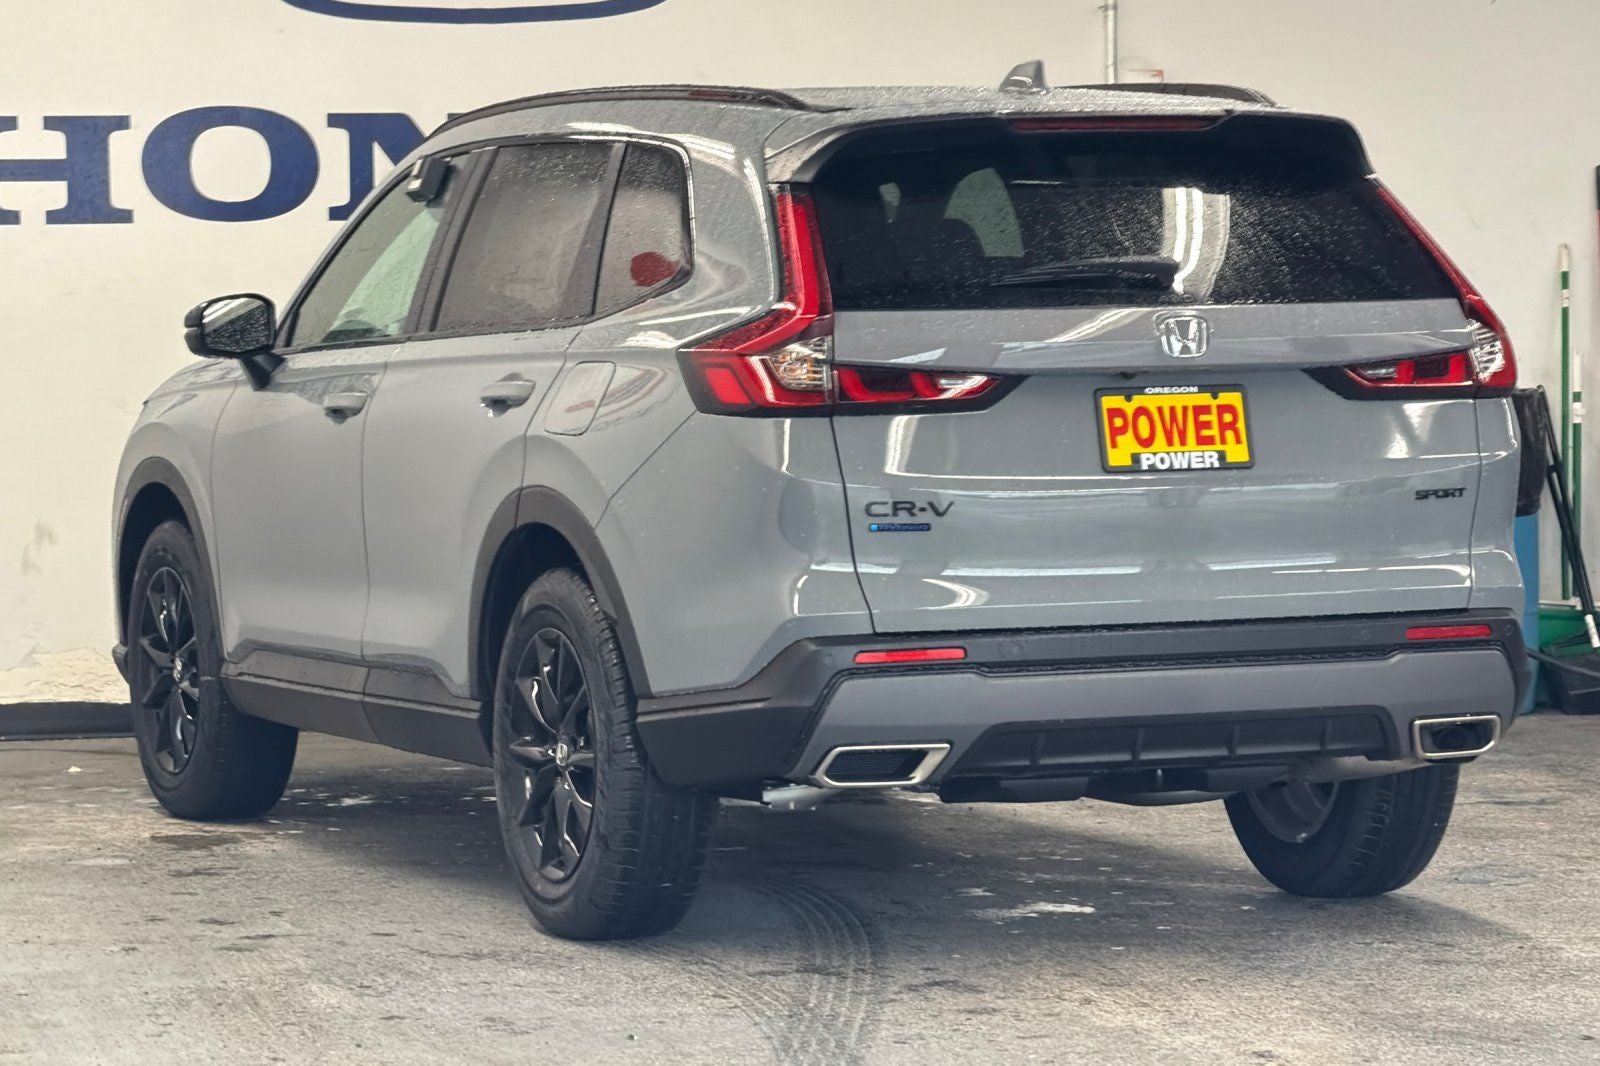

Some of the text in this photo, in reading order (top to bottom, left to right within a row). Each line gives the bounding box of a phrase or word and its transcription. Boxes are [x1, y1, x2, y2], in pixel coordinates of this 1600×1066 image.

[1144, 385, 1199, 394] OREGON
[1106, 403, 1243, 449] POWER
[1140, 451, 1220, 470] POWER
[1415, 487, 1466, 500] SPORT
[865, 500, 954, 517] CR-V
